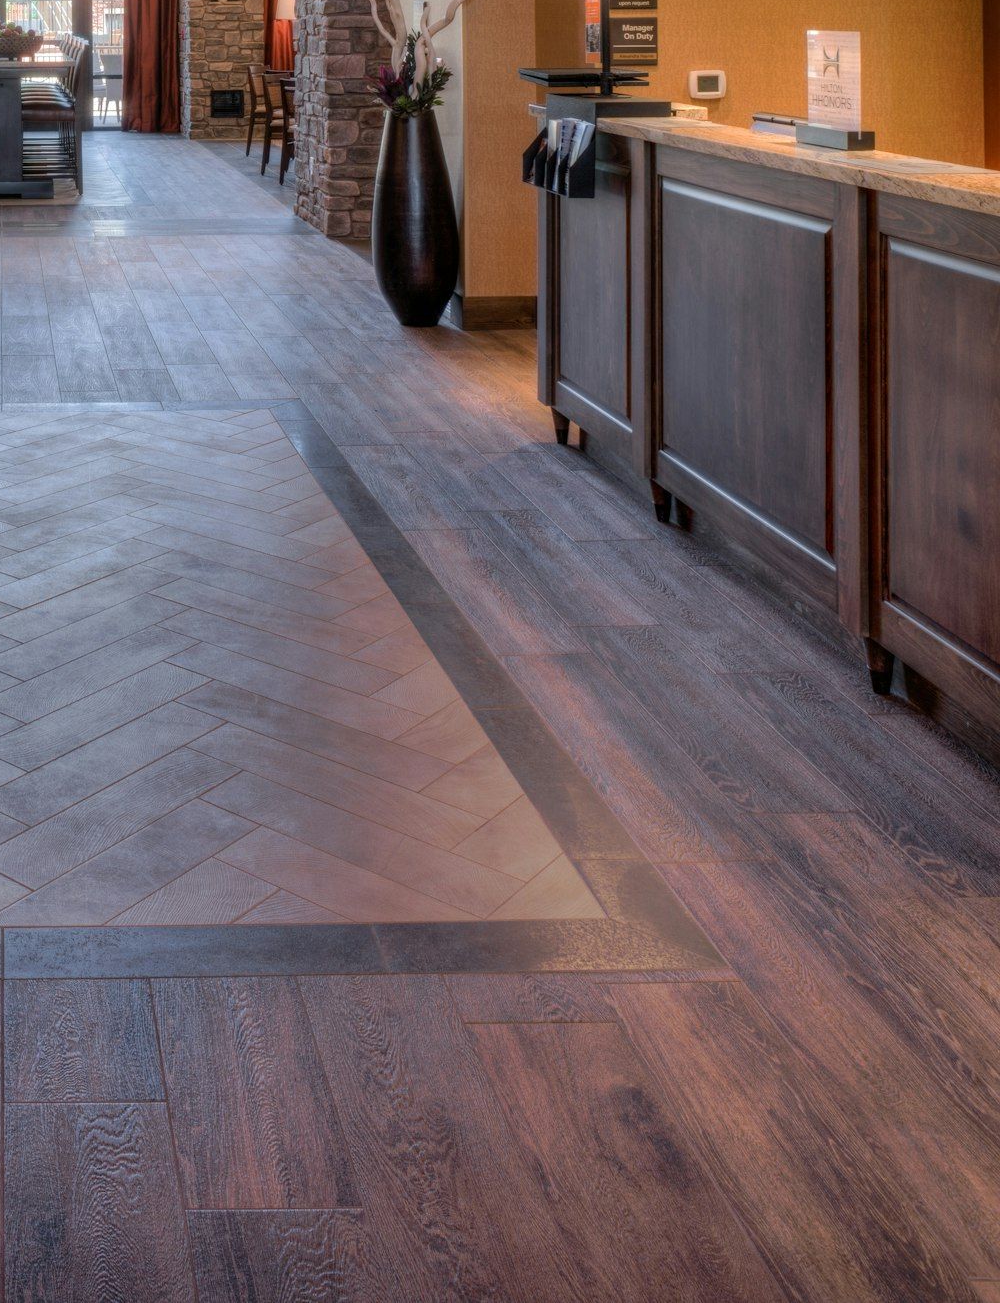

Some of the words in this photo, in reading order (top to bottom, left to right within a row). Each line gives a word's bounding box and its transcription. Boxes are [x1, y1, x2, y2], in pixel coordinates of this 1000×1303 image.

[622, 24, 654, 33] Manager
[636, 33, 654, 41] Duty
[820, 83, 843, 94] HILTON
[812, 94, 853, 110] HHONORS
